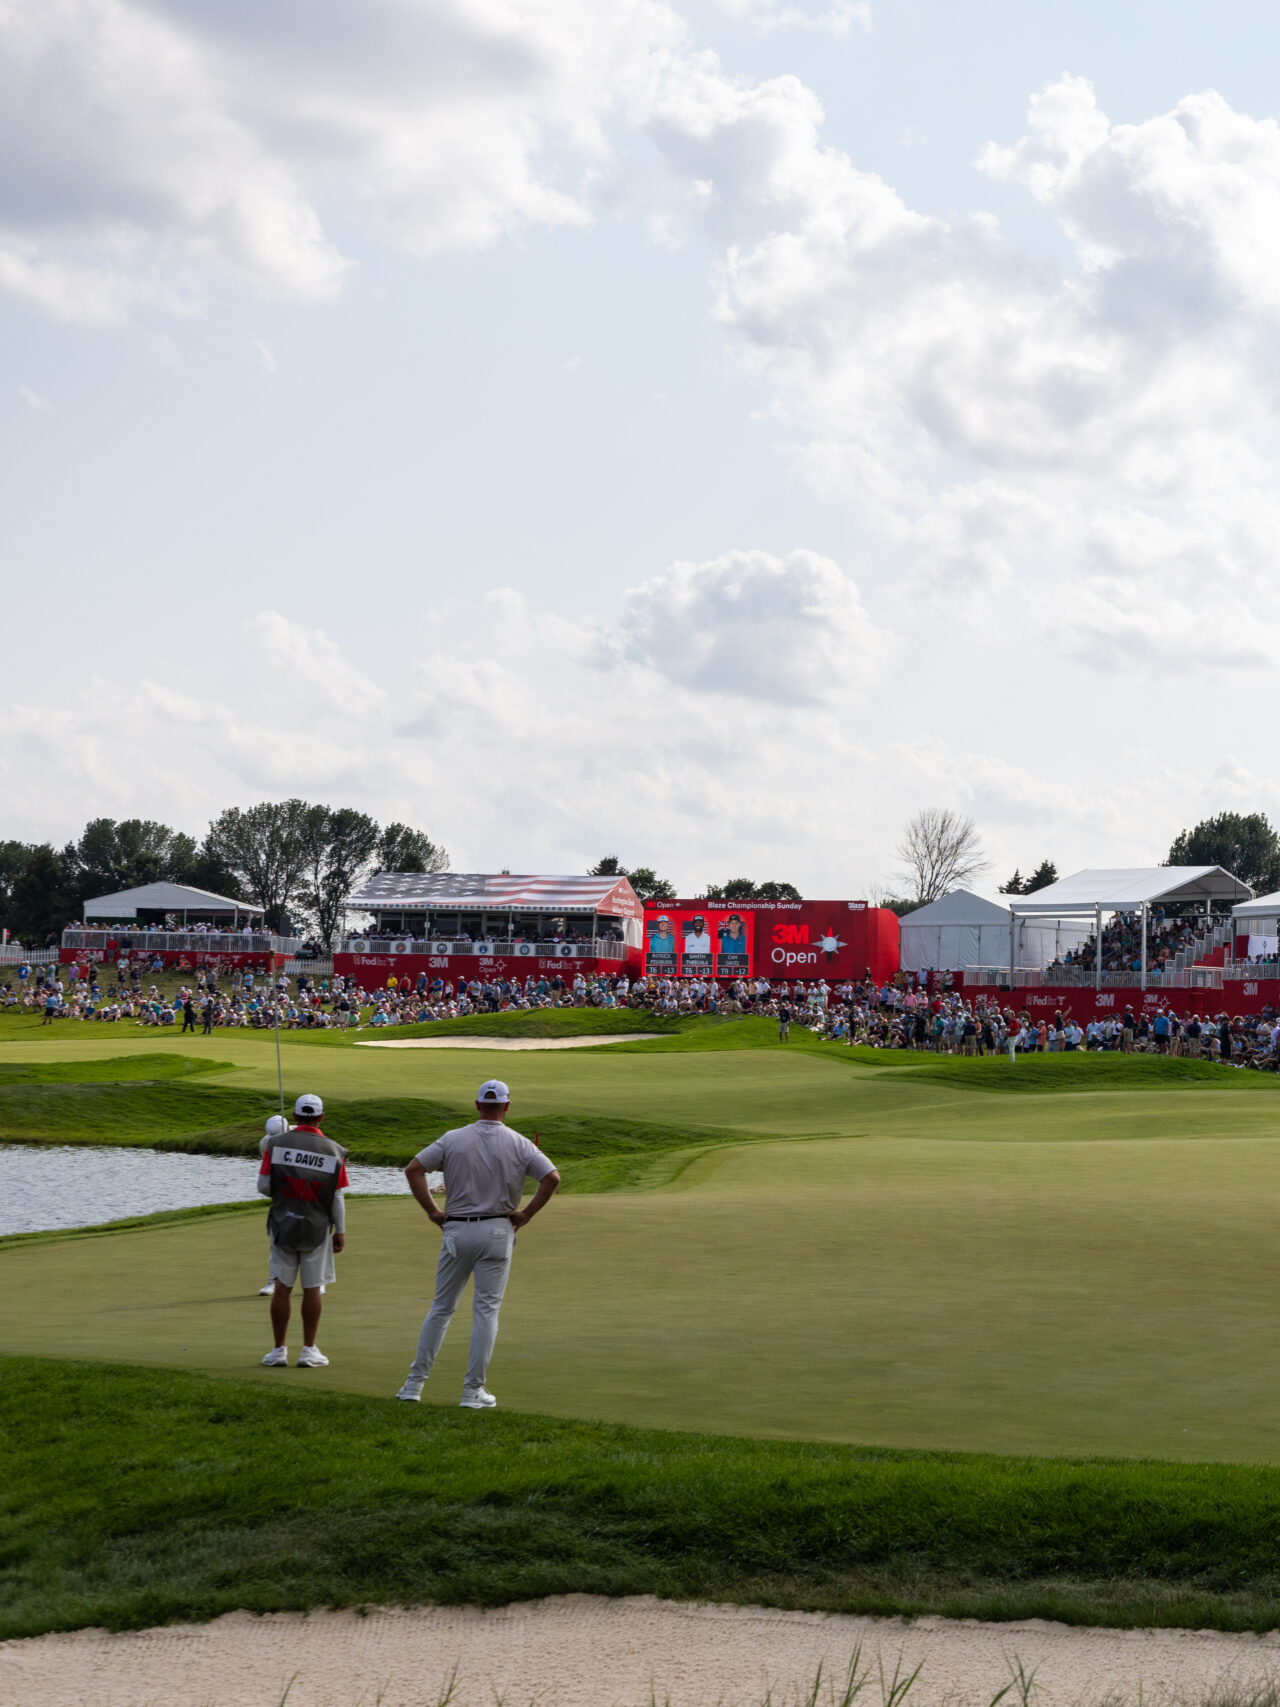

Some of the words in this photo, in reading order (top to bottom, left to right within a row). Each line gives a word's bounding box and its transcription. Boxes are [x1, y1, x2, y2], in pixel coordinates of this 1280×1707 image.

[728, 902, 776, 910] Championship
[777, 902, 802, 910] Sunday
[772, 923, 810, 944] 3M
[428, 957, 449, 968] 3M
[479, 958, 494, 966] 3M
[771, 947, 817, 966] Open
[479, 966, 497, 974] Open
[1243, 982, 1258, 996] 3M
[1095, 993, 1115, 1007] 3M
[1143, 993, 1158, 1004] 3M
[284, 1151, 292, 1162] C.
[295, 1152, 325, 1168] DAVIS
[280, 1175, 321, 1202] 3M
